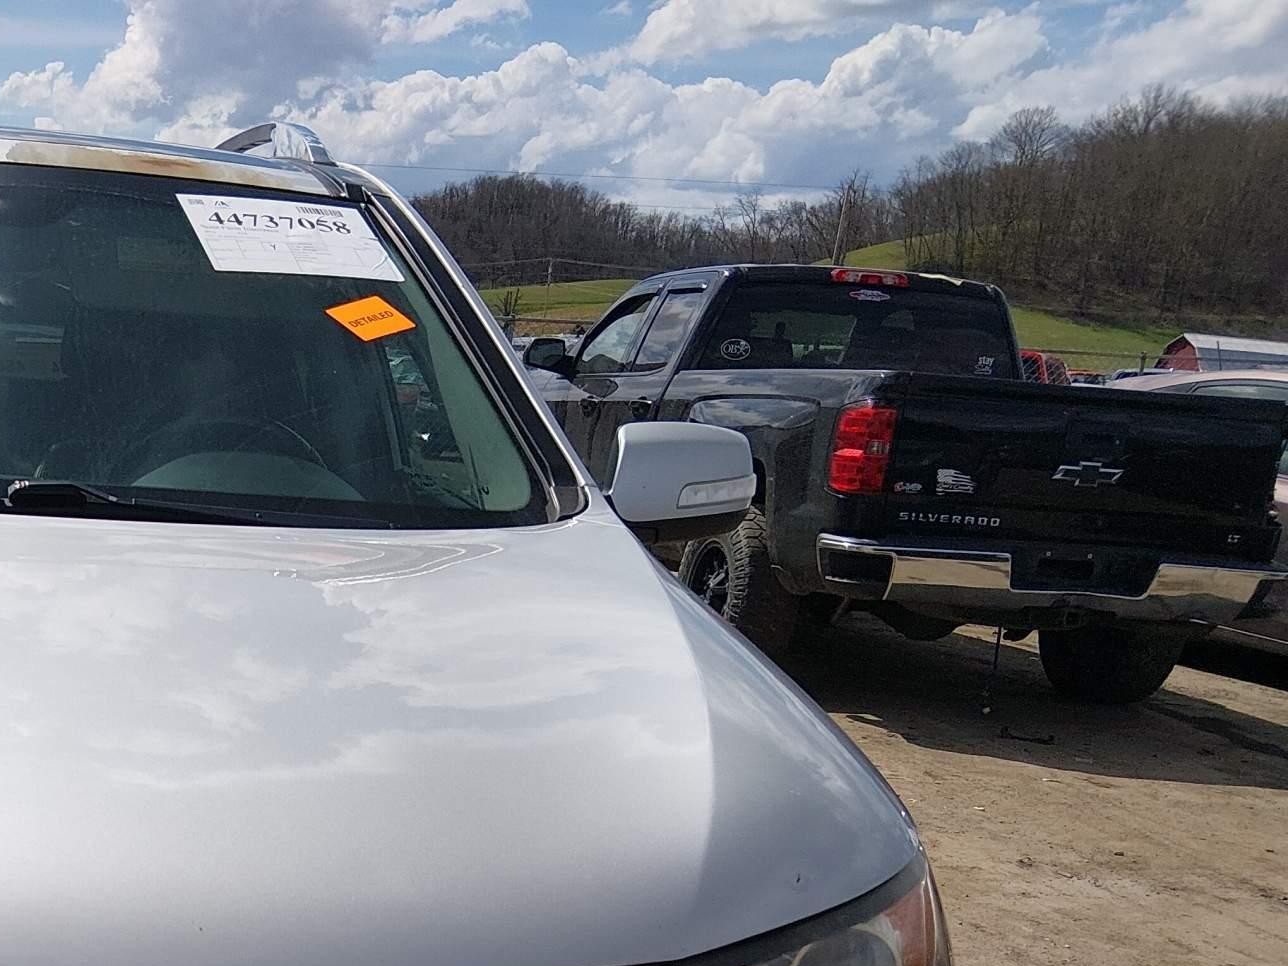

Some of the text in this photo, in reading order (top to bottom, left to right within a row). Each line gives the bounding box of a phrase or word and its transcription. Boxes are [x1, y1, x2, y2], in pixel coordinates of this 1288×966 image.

[208, 211, 352, 235] 44737058
[348, 310, 394, 328] DETAILED
[898, 512, 1001, 527] SILVERADO
